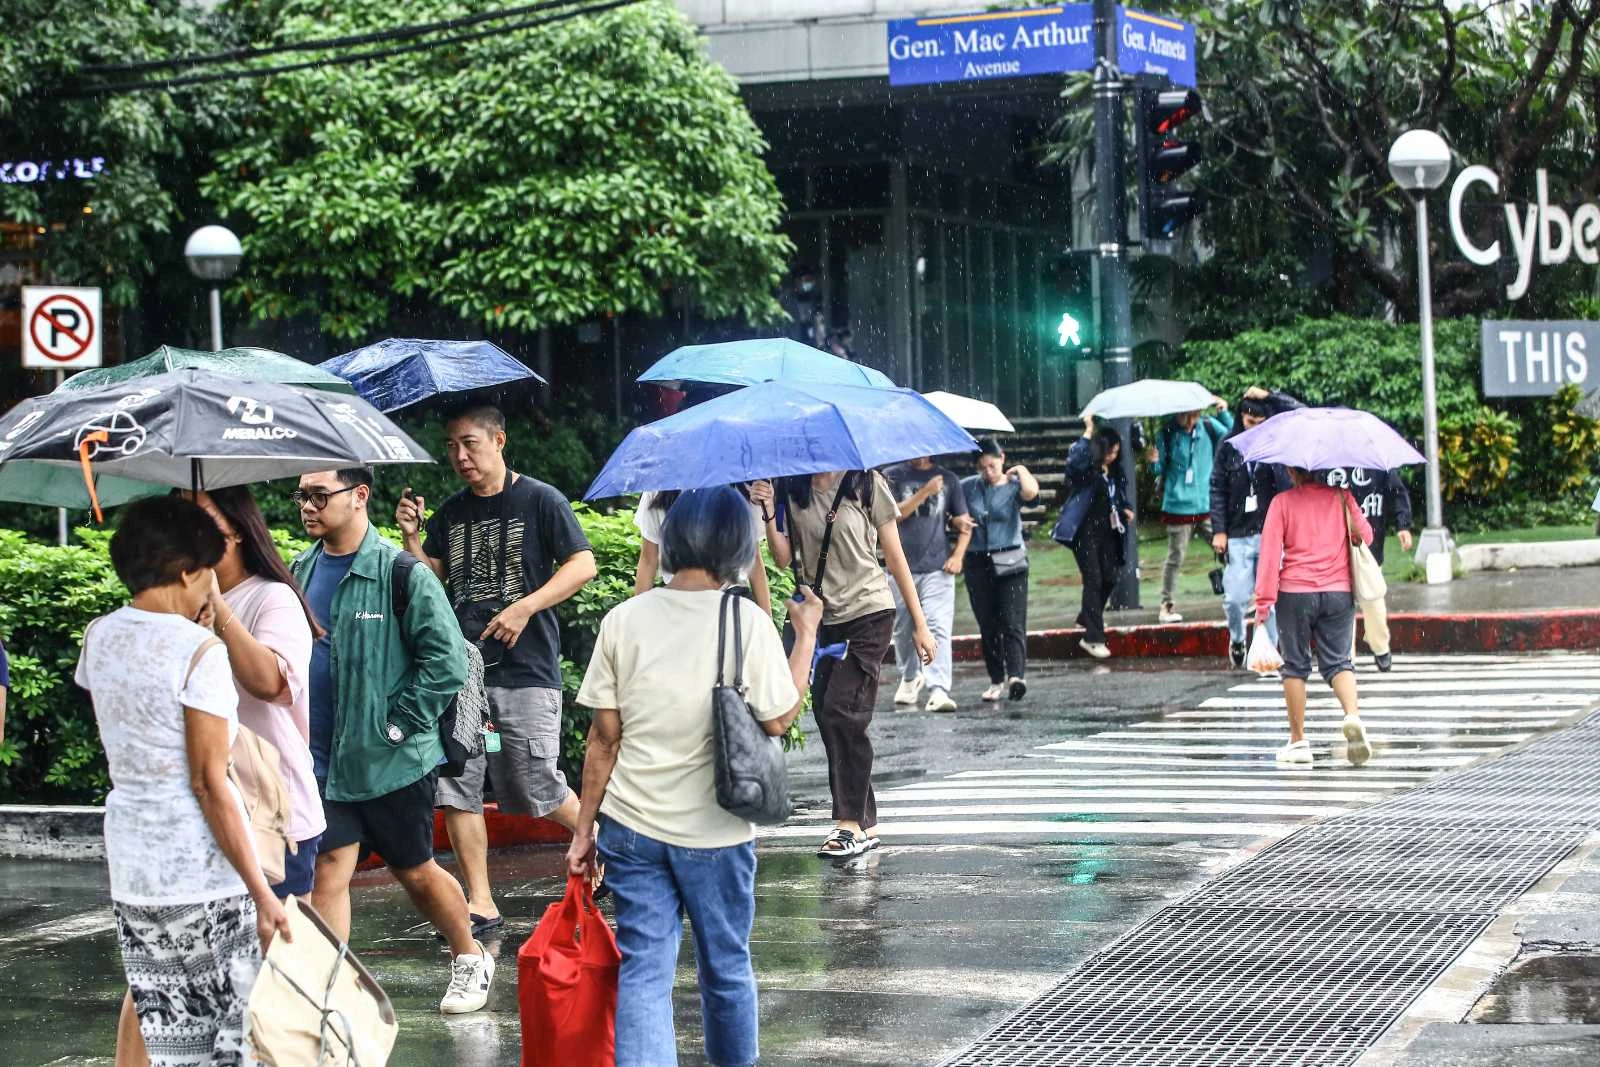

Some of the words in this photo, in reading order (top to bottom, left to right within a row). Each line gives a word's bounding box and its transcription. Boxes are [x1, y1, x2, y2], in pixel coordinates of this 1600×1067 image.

[890, 35, 945, 60] Gen.
[954, 28, 1005, 54] Mac
[1012, 22, 1092, 50] Arthur
[1123, 23, 1147, 52] Gen.
[1148, 30, 1187, 61] Araneta
[964, 60, 1021, 79] Avenue
[1499, 331, 1588, 383] THIS
[222, 427, 298, 440] MERALCO
